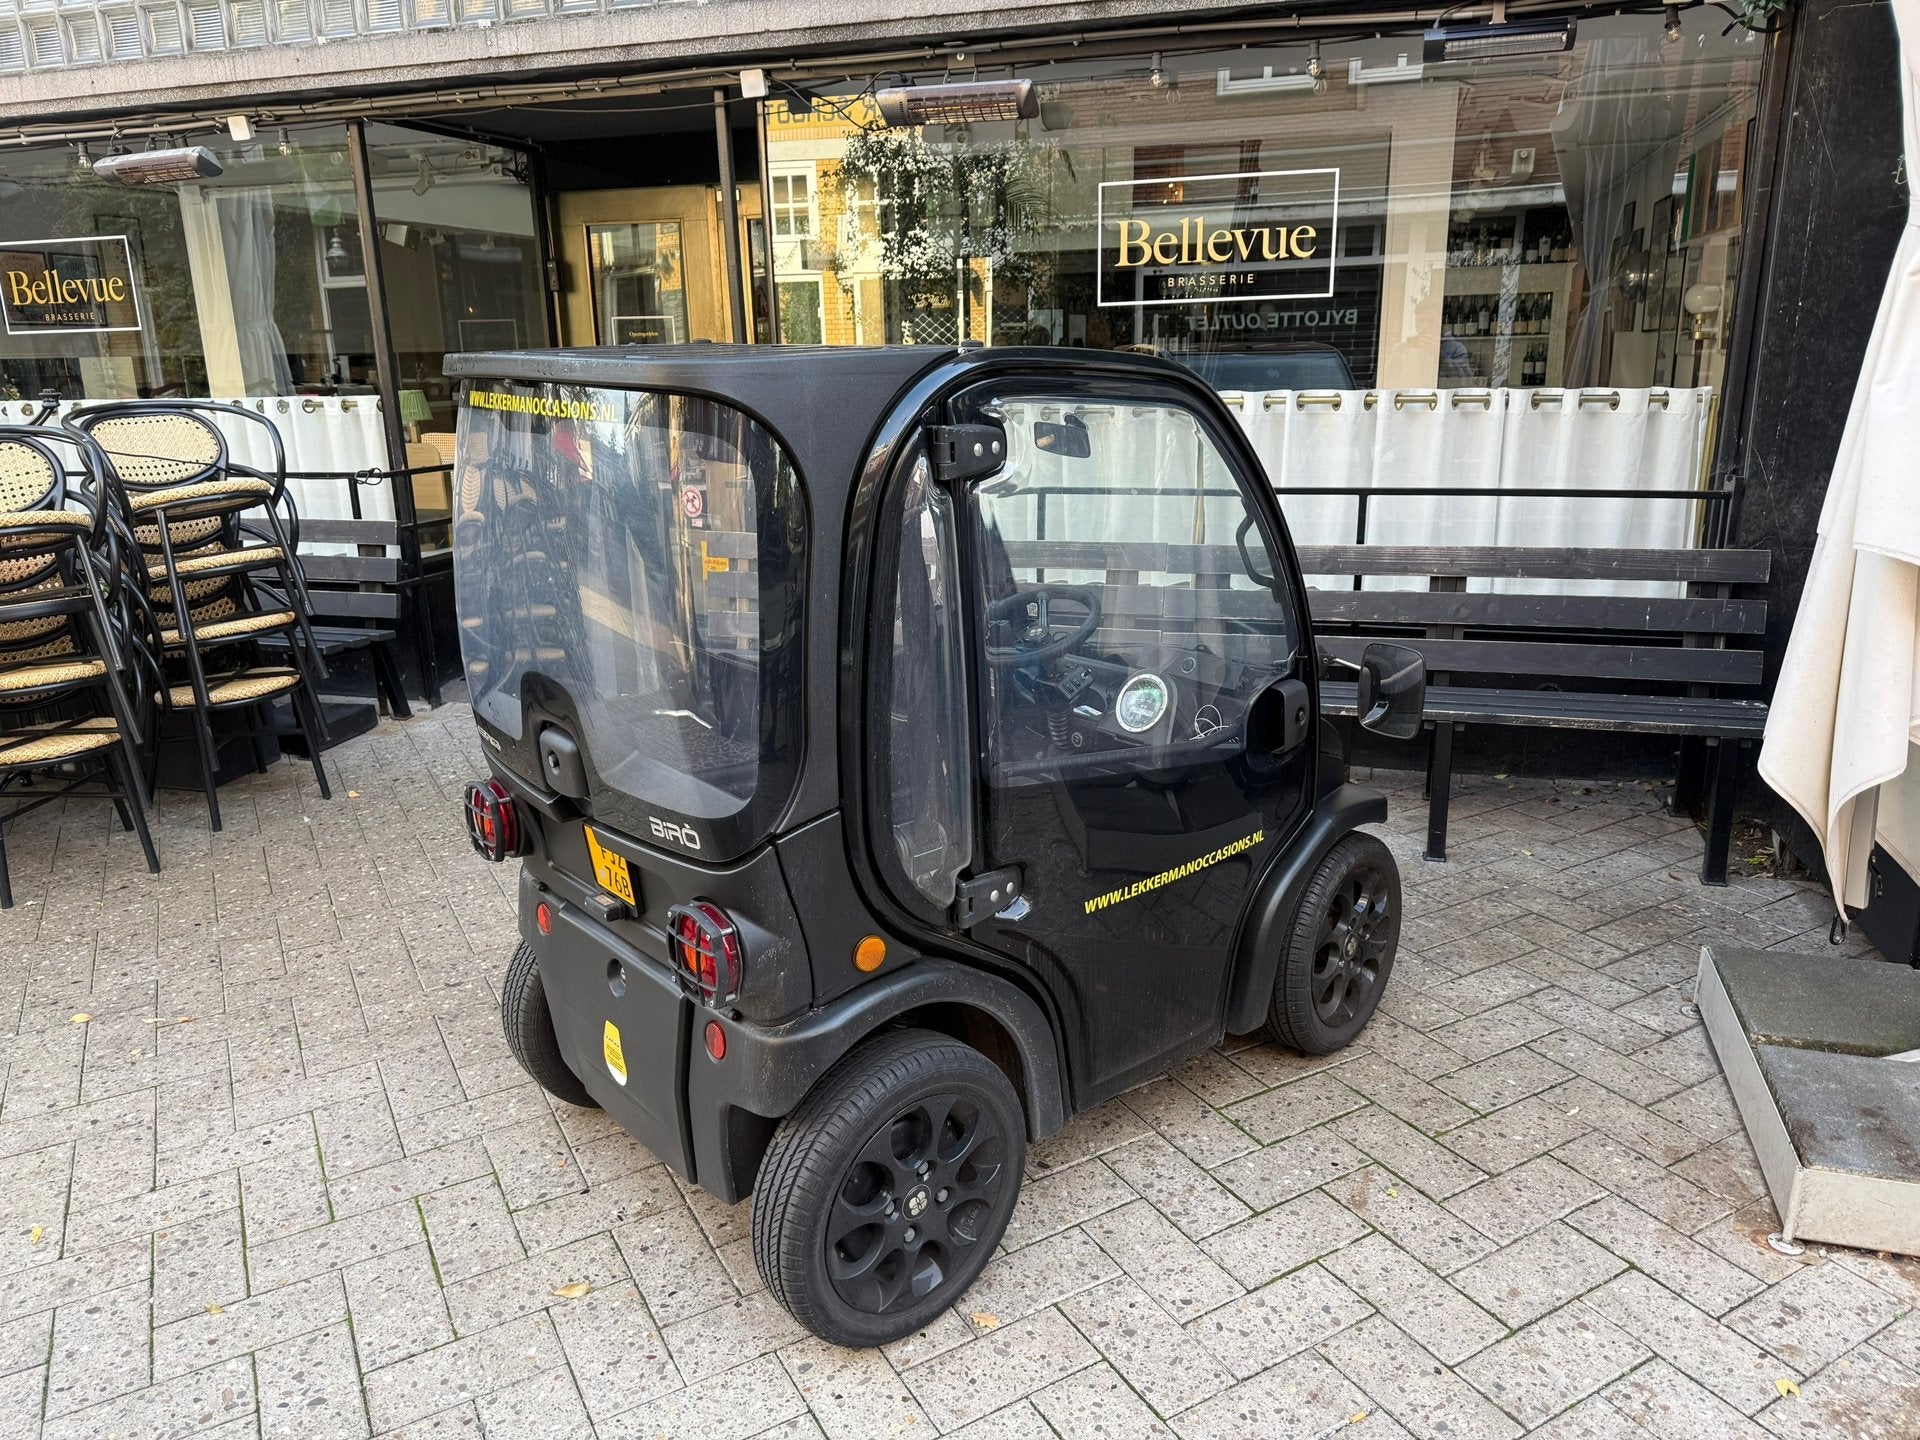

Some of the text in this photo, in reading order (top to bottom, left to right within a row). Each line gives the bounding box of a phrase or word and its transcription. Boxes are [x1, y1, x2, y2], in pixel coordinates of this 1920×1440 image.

[1114, 216, 1317, 267] Bellevue
[7, 269, 126, 305] Bellevue
[1167, 273, 1255, 287] BRASSERIE
[45, 312, 96, 321] BRASSERIE
[469, 390, 619, 422] WWW.LEKKERMANOCCASIONS.NL
[605, 865, 631, 898] 76B
[1084, 829, 1265, 914] WWW.LEKKERMANOCCASIONS.NL
